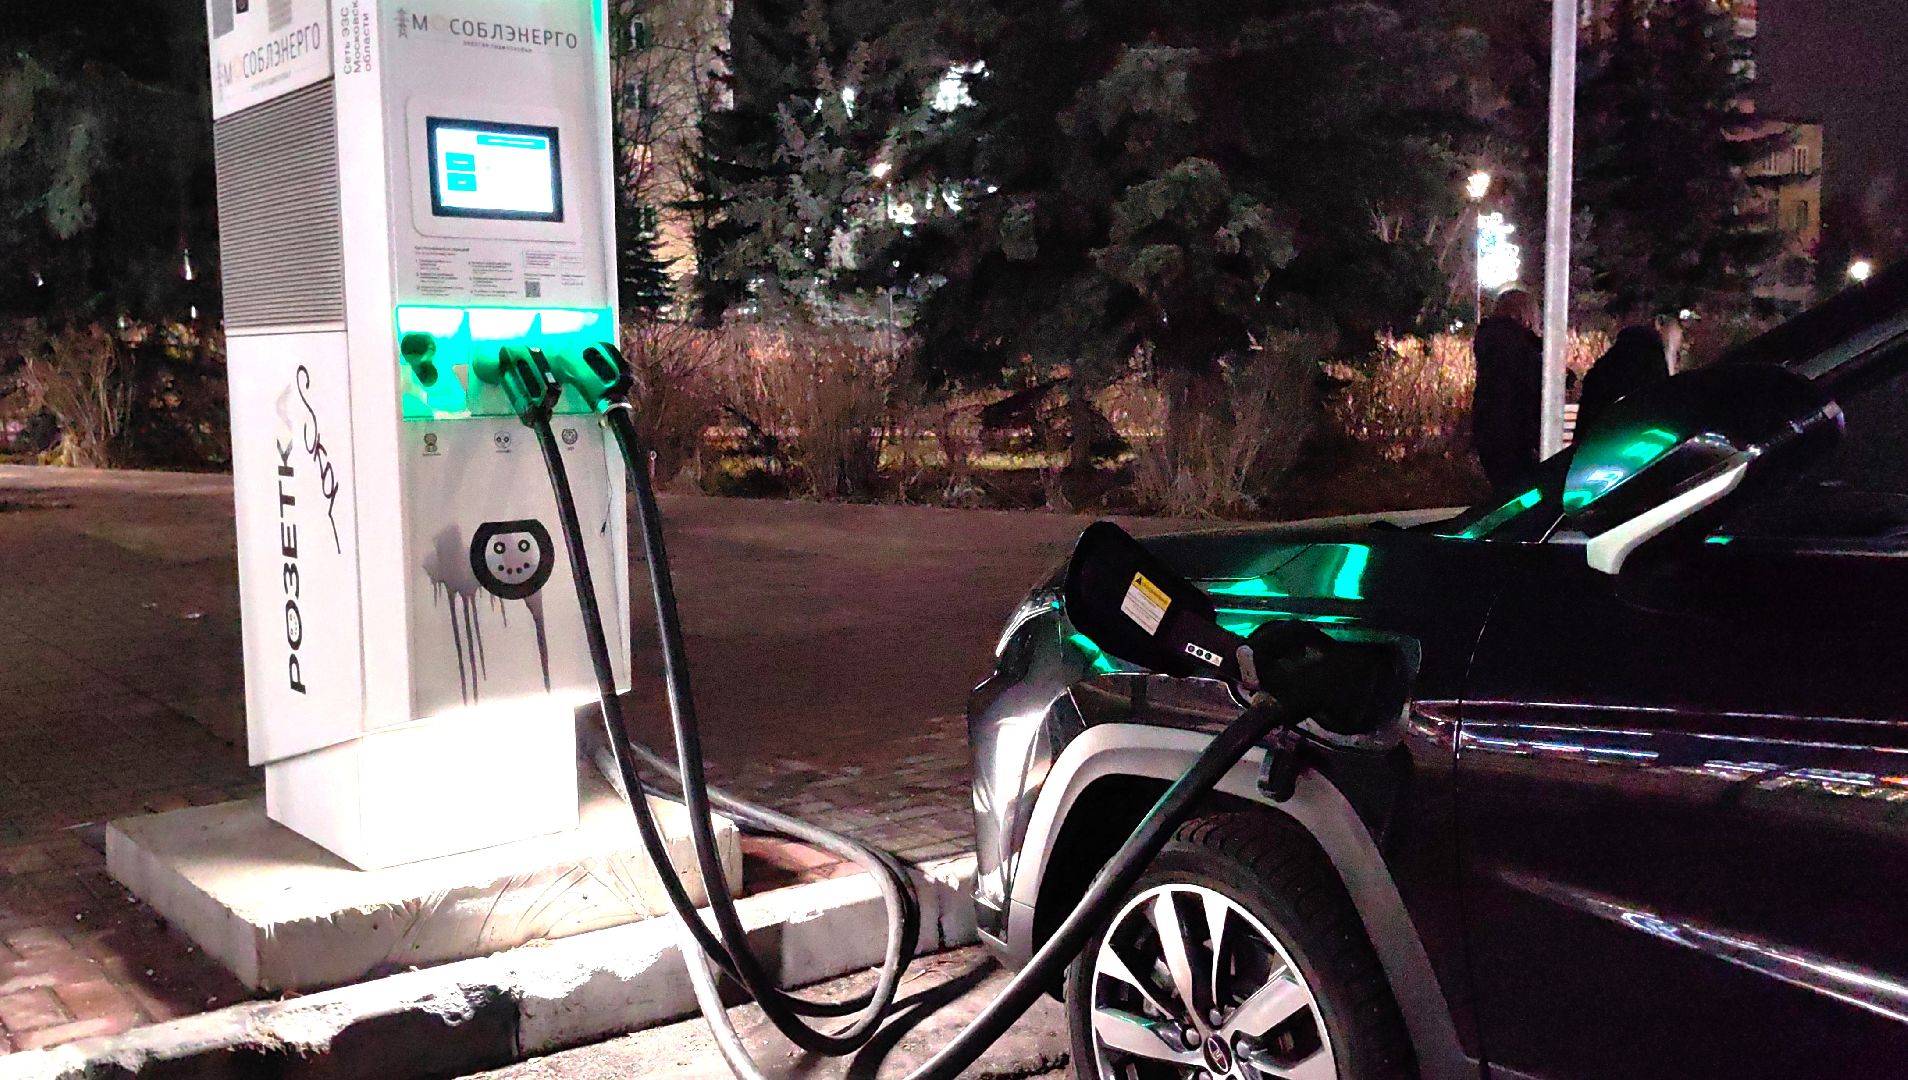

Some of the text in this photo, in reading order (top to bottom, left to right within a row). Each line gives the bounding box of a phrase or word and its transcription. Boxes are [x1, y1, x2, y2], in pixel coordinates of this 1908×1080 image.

[340, 7, 352, 75] Сеть ЭЗС
[362, 13, 372, 72] области
